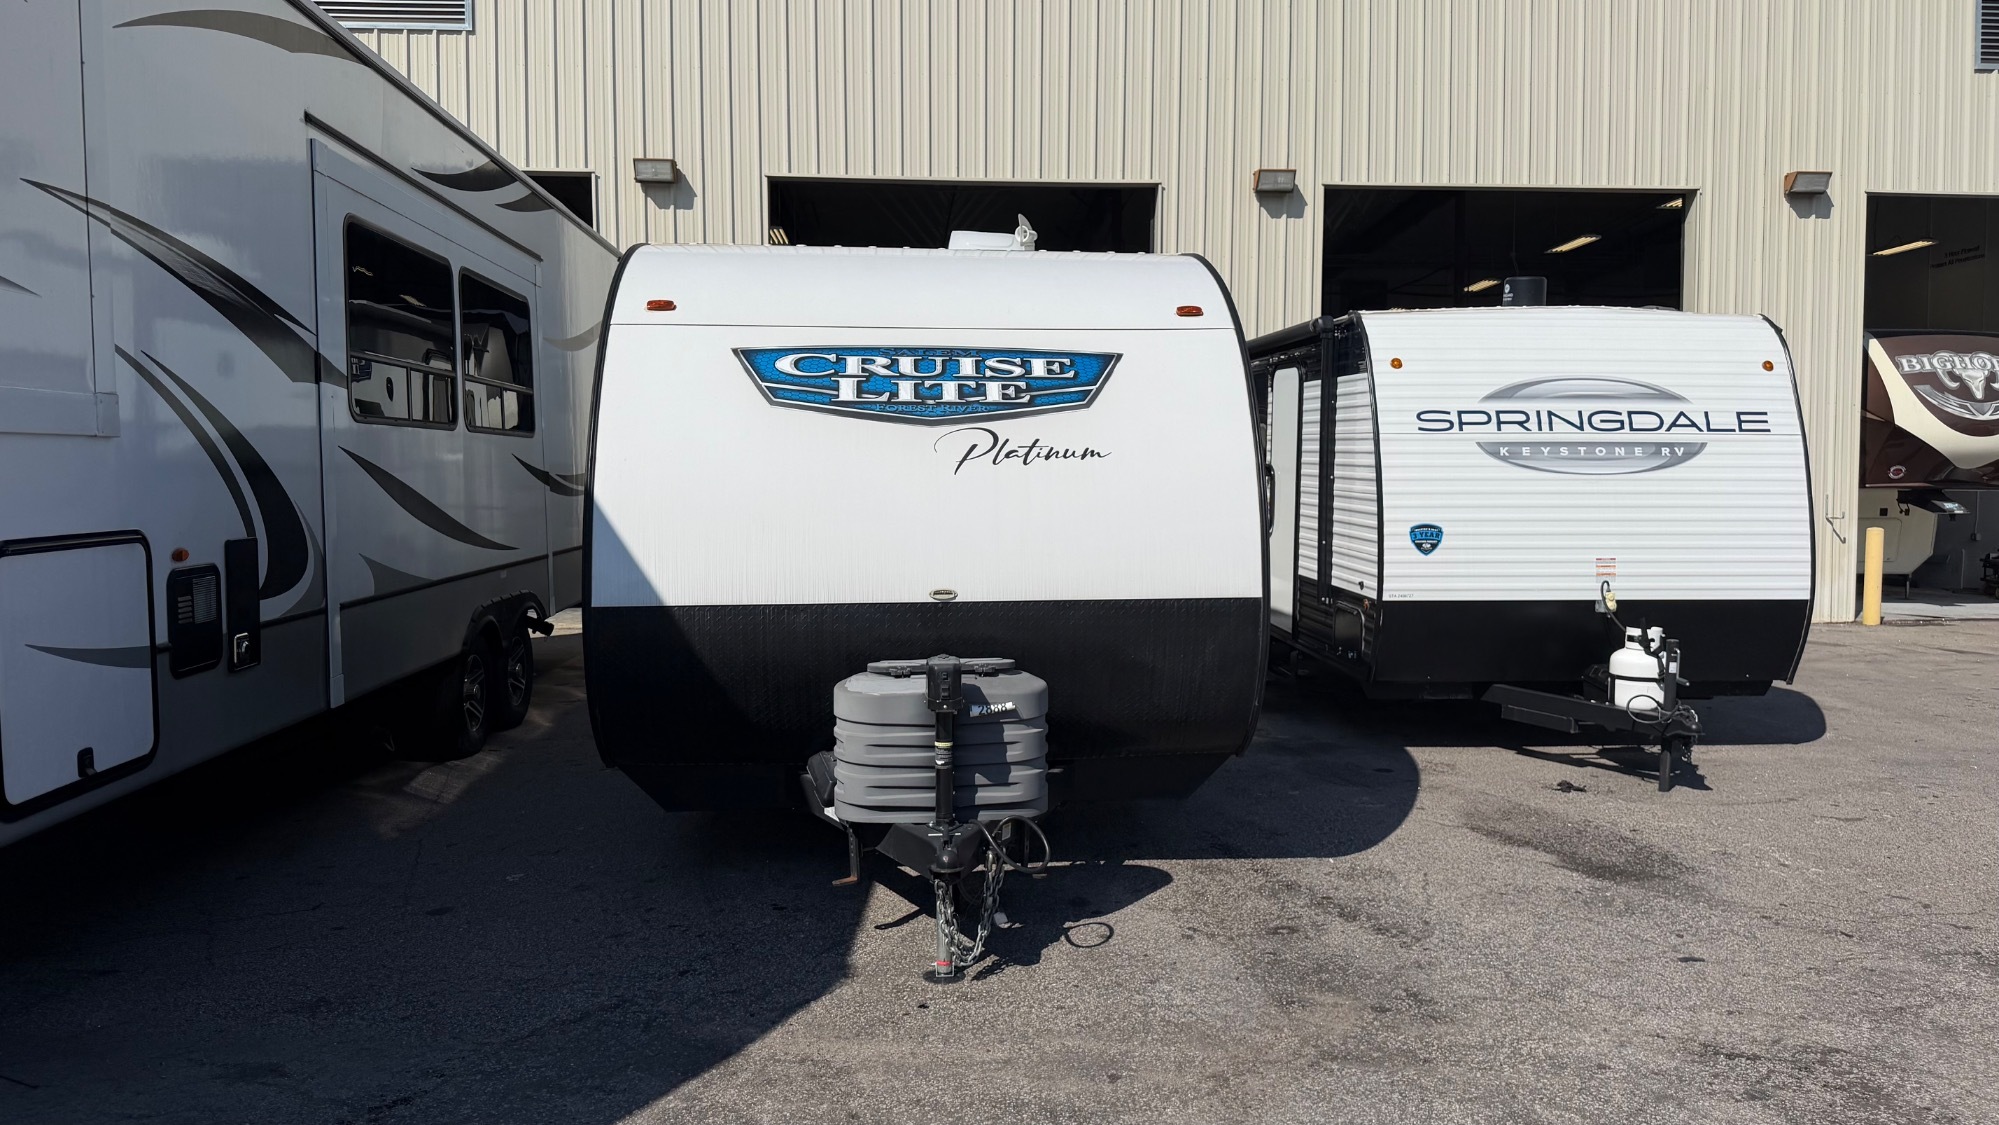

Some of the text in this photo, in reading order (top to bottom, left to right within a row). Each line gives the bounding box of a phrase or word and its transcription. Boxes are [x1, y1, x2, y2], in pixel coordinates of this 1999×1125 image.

[879, 348, 980, 357] SALEM
[774, 353, 1076, 378] CRUISE
[831, 377, 1031, 403] LITE
[876, 403, 989, 413] FOREST RIVER
[1416, 409, 1772, 433] SPRINGDALE
[933, 427, 1113, 476] Platinum
[1499, 446, 1685, 457] KEYSTONE RV
[1419, 531, 1441, 540] YEAR
